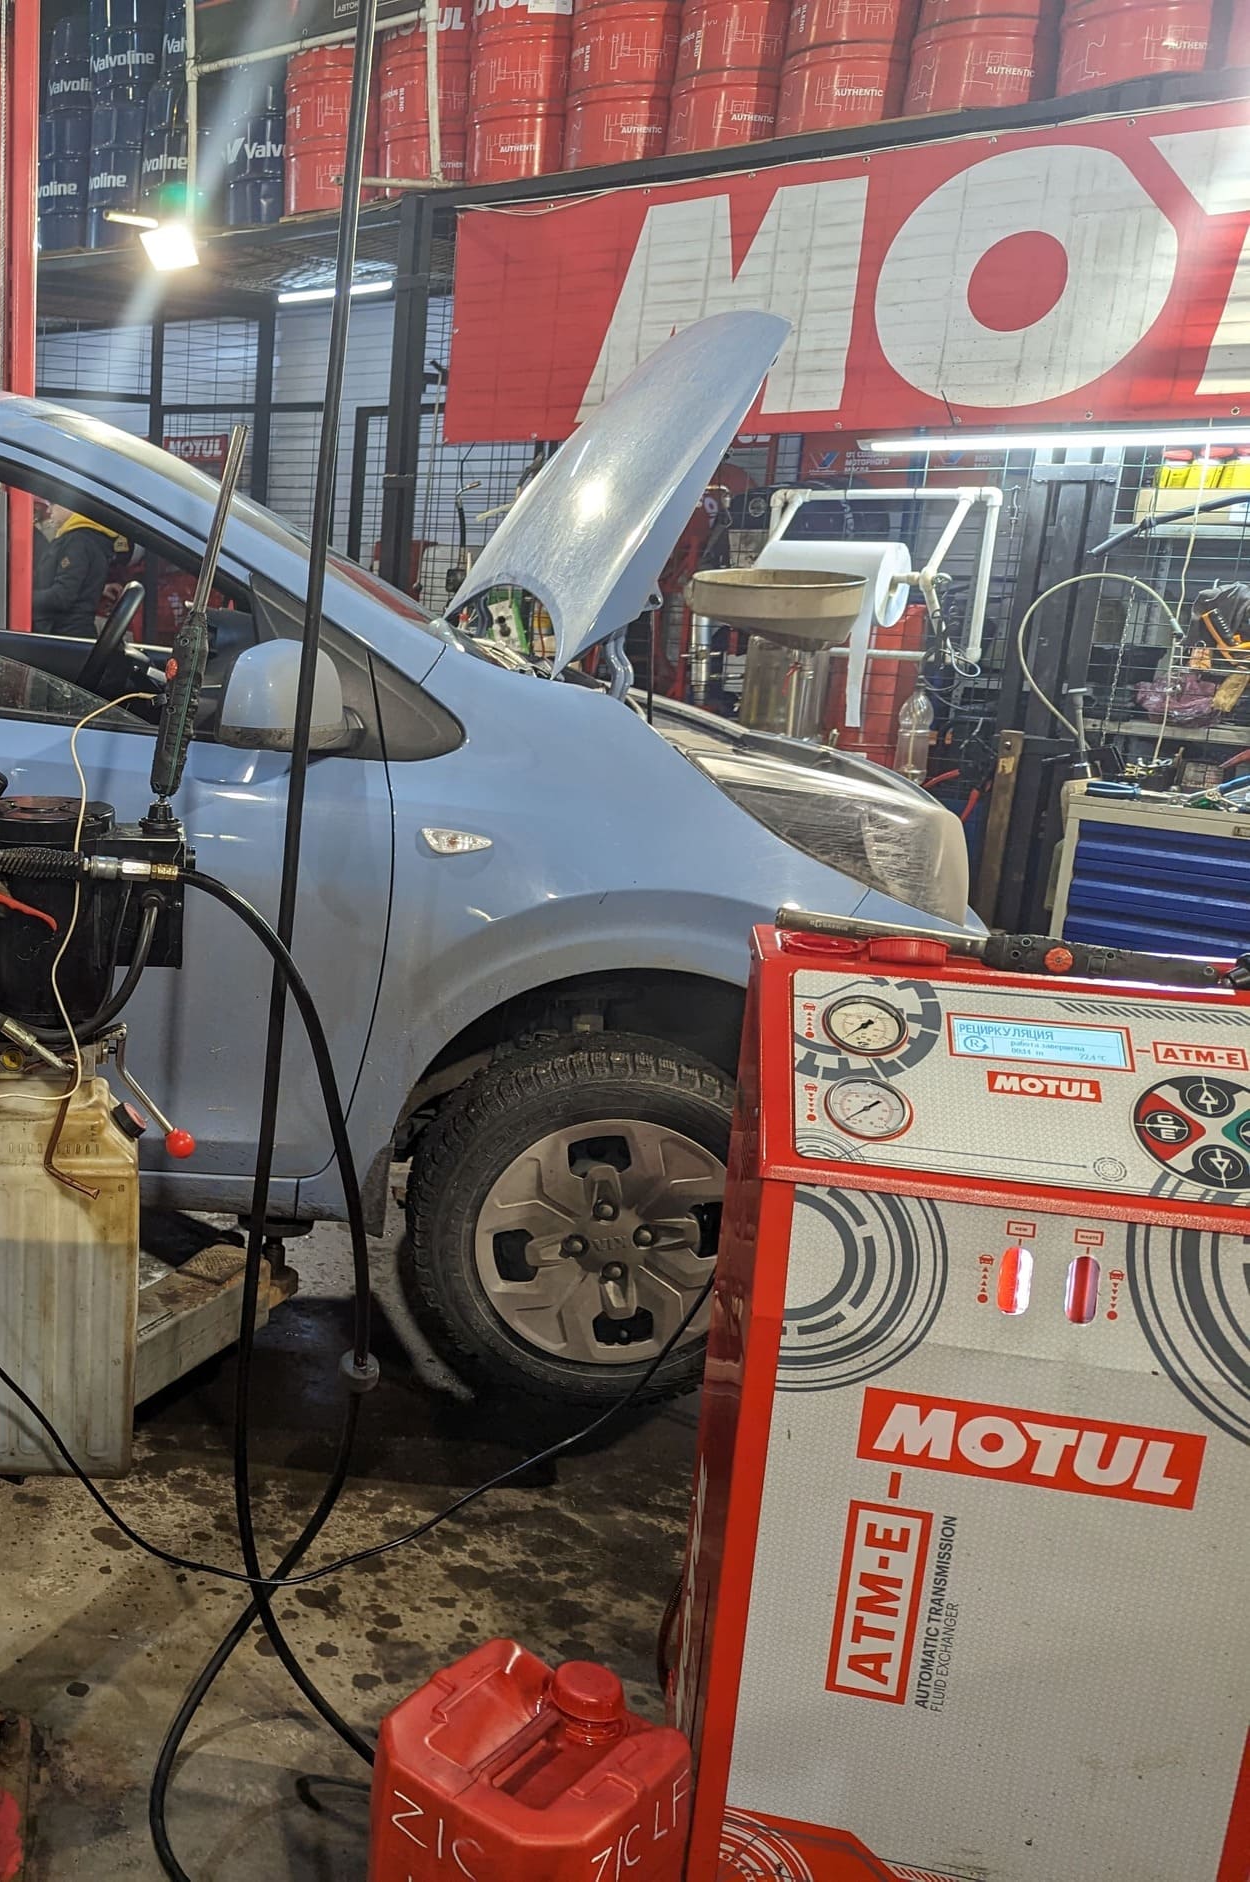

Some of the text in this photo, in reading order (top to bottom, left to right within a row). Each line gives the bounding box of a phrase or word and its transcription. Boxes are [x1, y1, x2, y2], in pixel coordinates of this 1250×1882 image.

[92, 50, 156, 73] Valvoline
[985, 66, 1036, 78] AUTHENTIC
[49, 77, 92, 96] Valvoli
[834, 87, 884, 97] AUTHENTIC
[731, 113, 775, 123] AUTHENTIC
[621, 126, 663, 135] AUTHENTIC
[38, 181, 78, 198] voline
[89, 173, 128, 191] voline
[168, 438, 223, 458] MOTUL
[1163, 1047, 1240, 1065] ATM-E
[993, 1074, 1097, 1099] MOTUL
[871, 1402, 1182, 1496] MOTUL
[847, 1522, 911, 1686] ATM-E
[915, 1515, 958, 1709] AUTOMATIC TRANSMISSION
[930, 1602, 959, 1713] FLUID EXCHANGER
